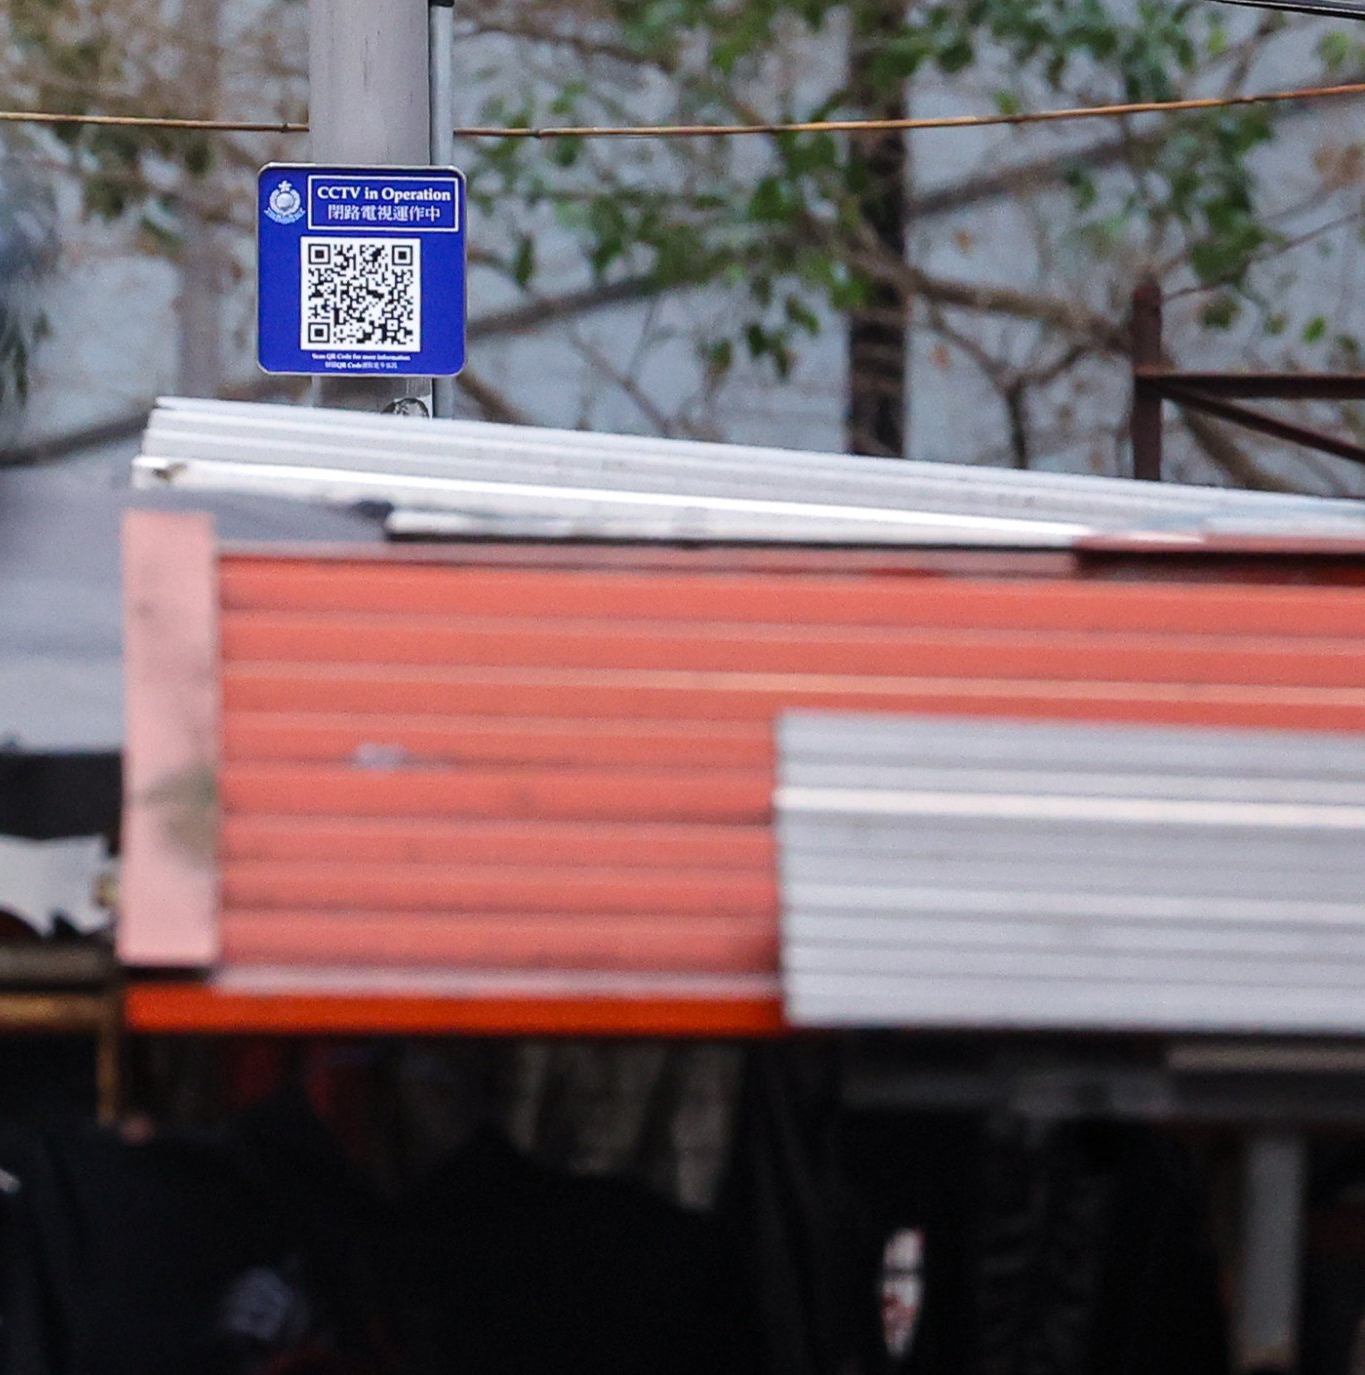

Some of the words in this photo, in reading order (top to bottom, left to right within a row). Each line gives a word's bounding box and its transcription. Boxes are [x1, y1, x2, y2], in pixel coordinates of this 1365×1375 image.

[317, 186, 361, 200] CCTV
[364, 187, 378, 200] in
[381, 187, 451, 204] Operation
[328, 204, 441, 222] 閉路電視運作中
